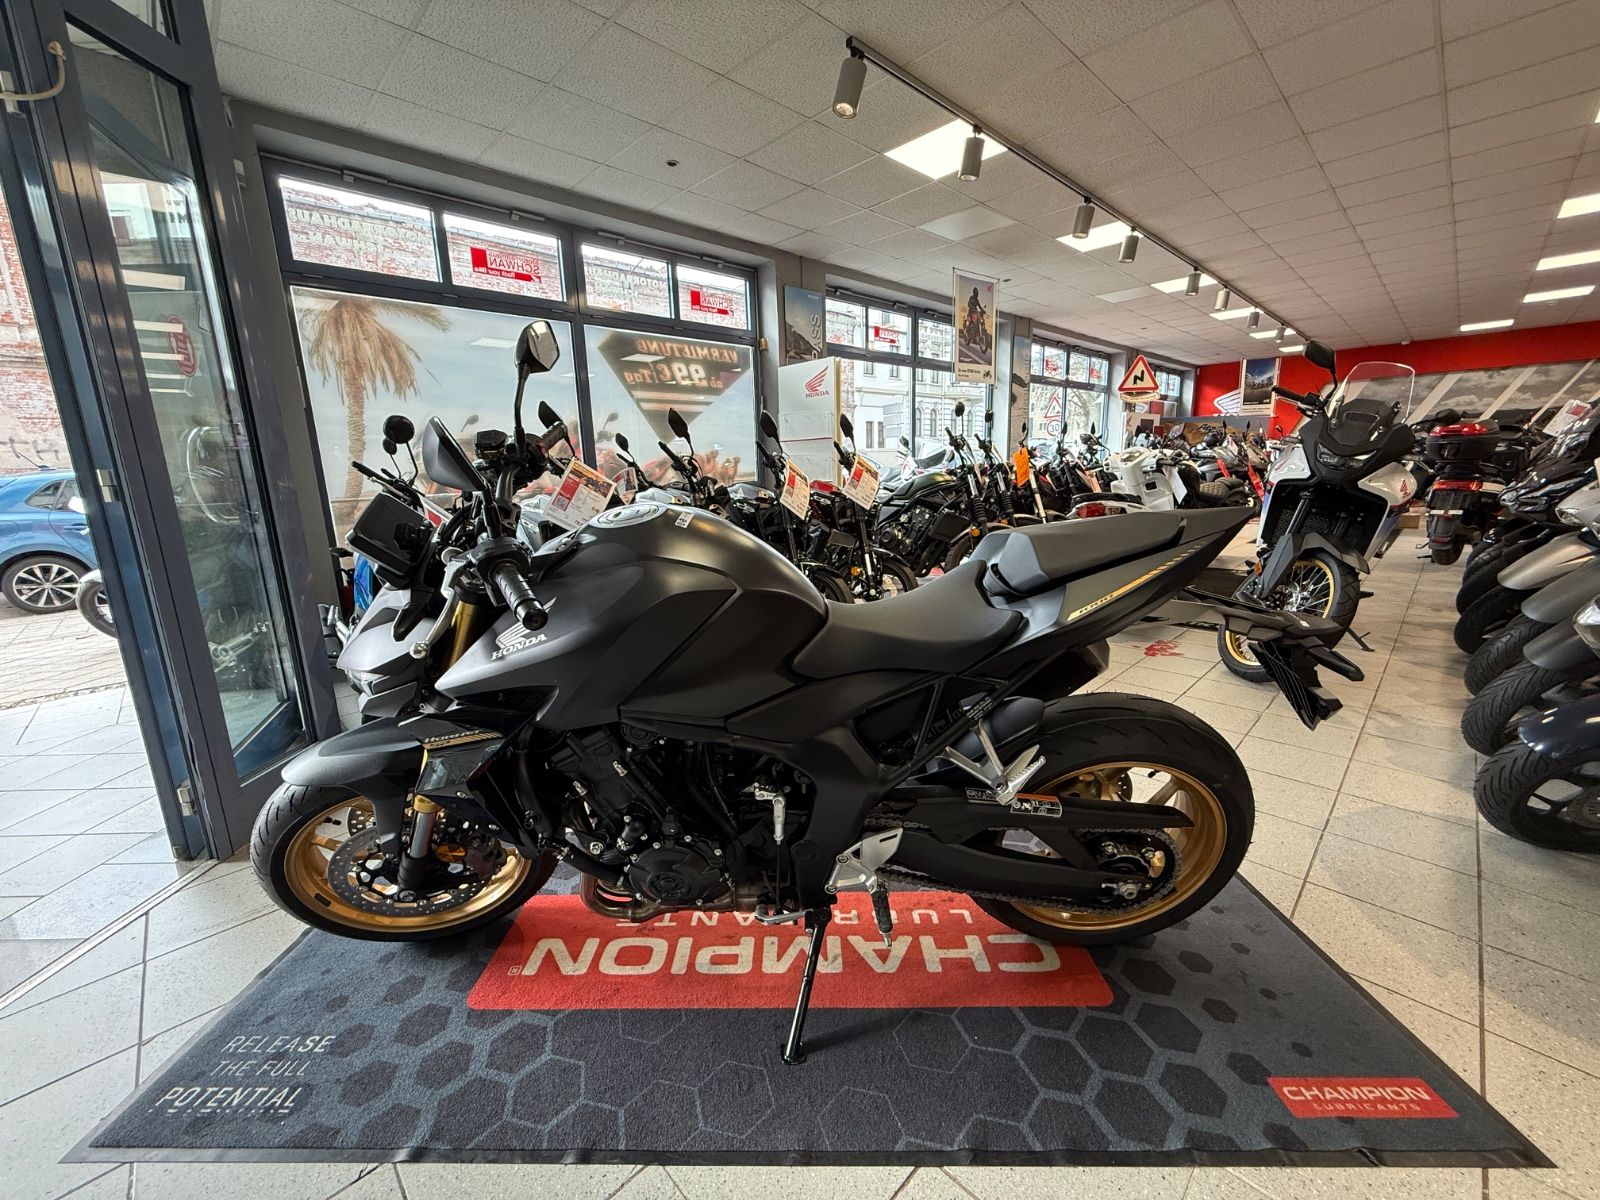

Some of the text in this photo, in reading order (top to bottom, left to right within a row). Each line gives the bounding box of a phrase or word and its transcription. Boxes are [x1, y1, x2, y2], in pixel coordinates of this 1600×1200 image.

[805, 390, 830, 398] HONDA
[1049, 423, 1060, 433] 30
[490, 633, 548, 661] HONDA
[521, 935, 1061, 975] CHAMPION
[221, 1035, 336, 1053] RELEASE
[209, 1060, 311, 1077] THE FULL
[155, 1086, 303, 1108] POTENTIAL
[1282, 1086, 1431, 1101] CHAMPION
[1313, 1102, 1421, 1112] LUBRICANTS
